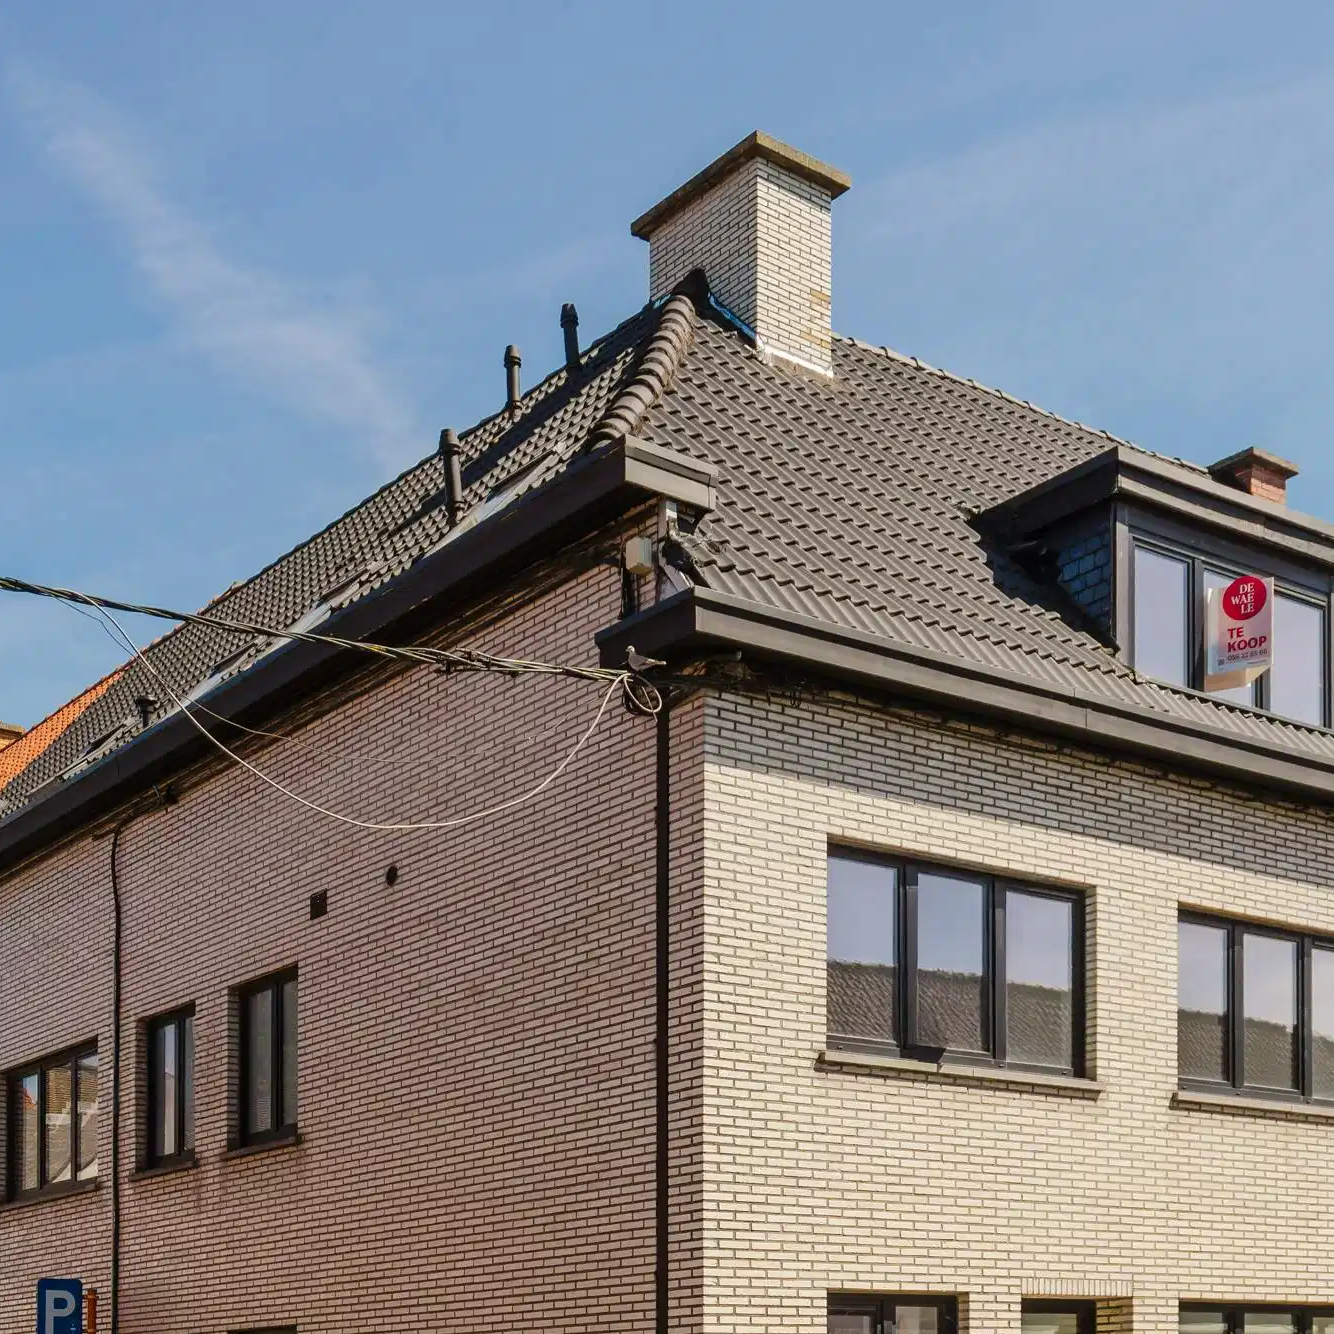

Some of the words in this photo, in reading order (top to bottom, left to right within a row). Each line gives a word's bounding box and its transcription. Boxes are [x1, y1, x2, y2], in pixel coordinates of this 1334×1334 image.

[1239, 583, 1255, 594] DE
[1231, 593, 1255, 605] WAE
[1241, 603, 1255, 614] LE
[1227, 626, 1244, 639] TE
[1227, 635, 1267, 653] KOOP
